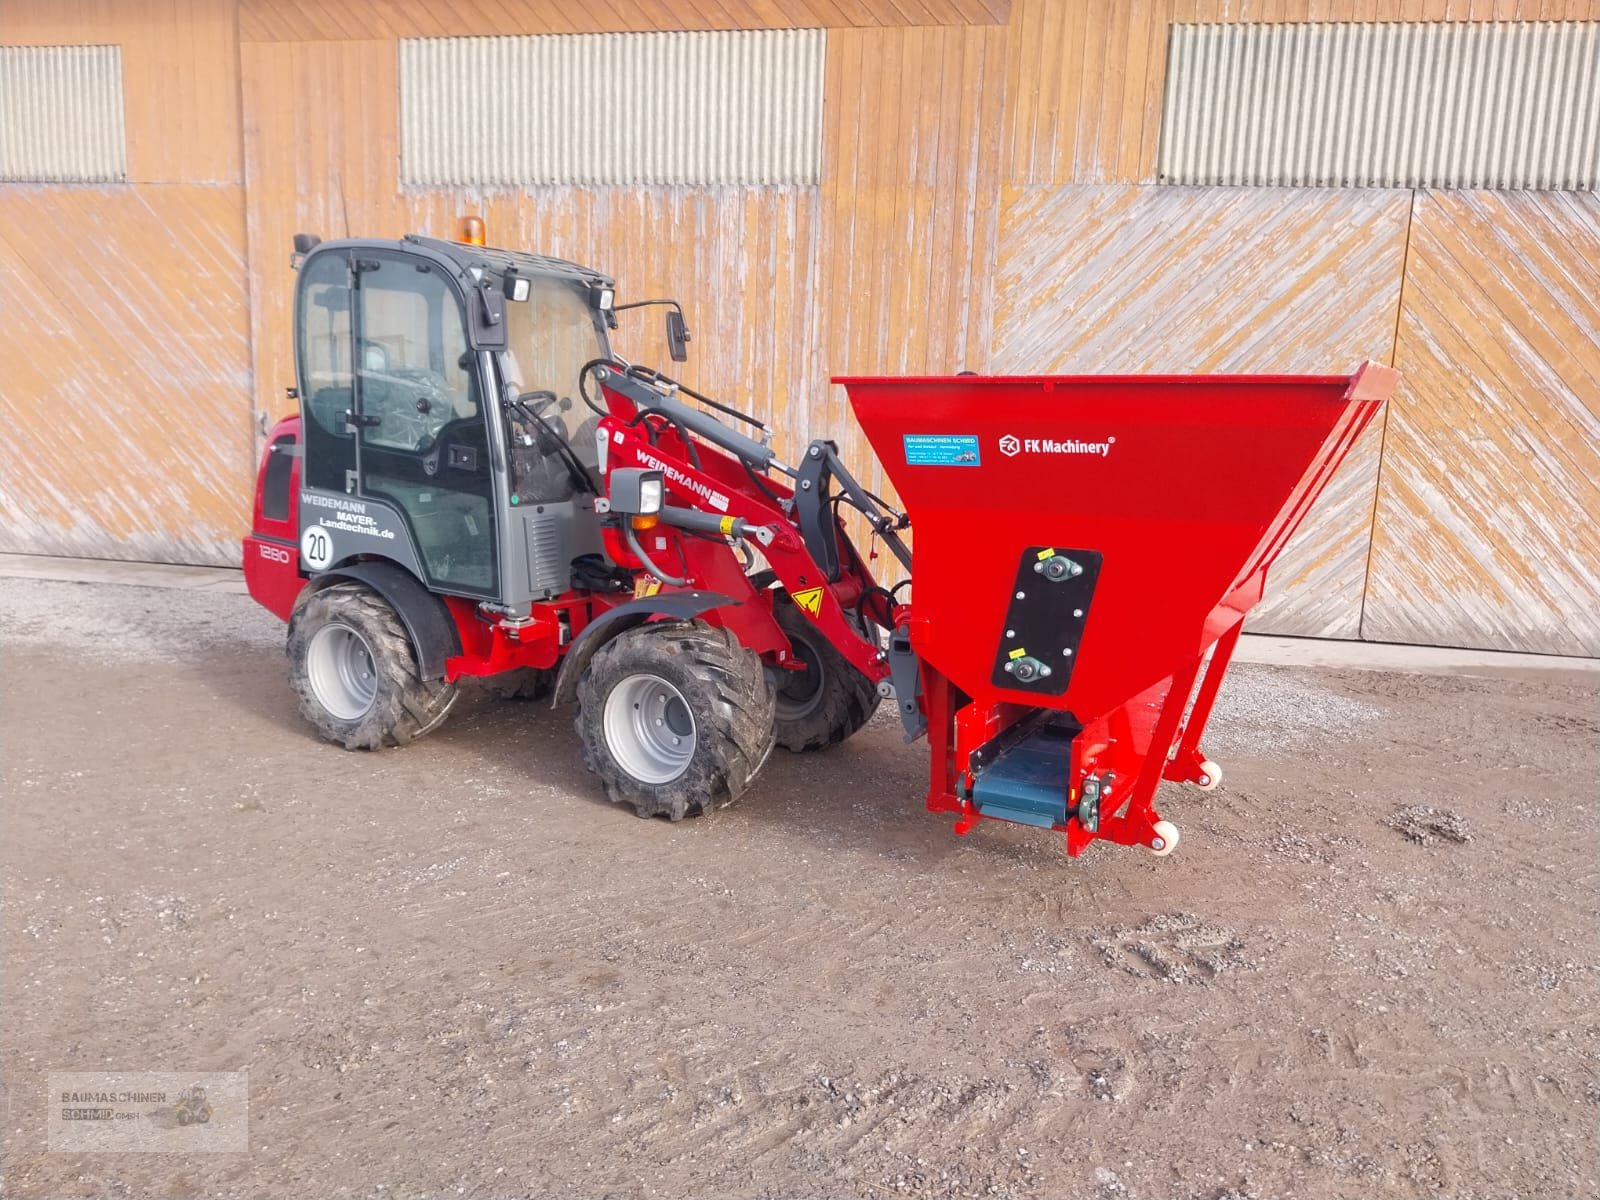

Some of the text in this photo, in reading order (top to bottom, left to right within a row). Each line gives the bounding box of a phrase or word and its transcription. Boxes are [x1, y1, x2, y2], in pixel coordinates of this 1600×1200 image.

[1024, 440, 1041, 453] FK
[636, 448, 711, 500] WEIDEMANN
[301, 493, 366, 514] WEIDEMANN
[319, 517, 395, 539] Landtechnik.de
[337, 511, 377, 526] MAYER-
[259, 544, 290, 564] 1280
[309, 534, 326, 561] 20
